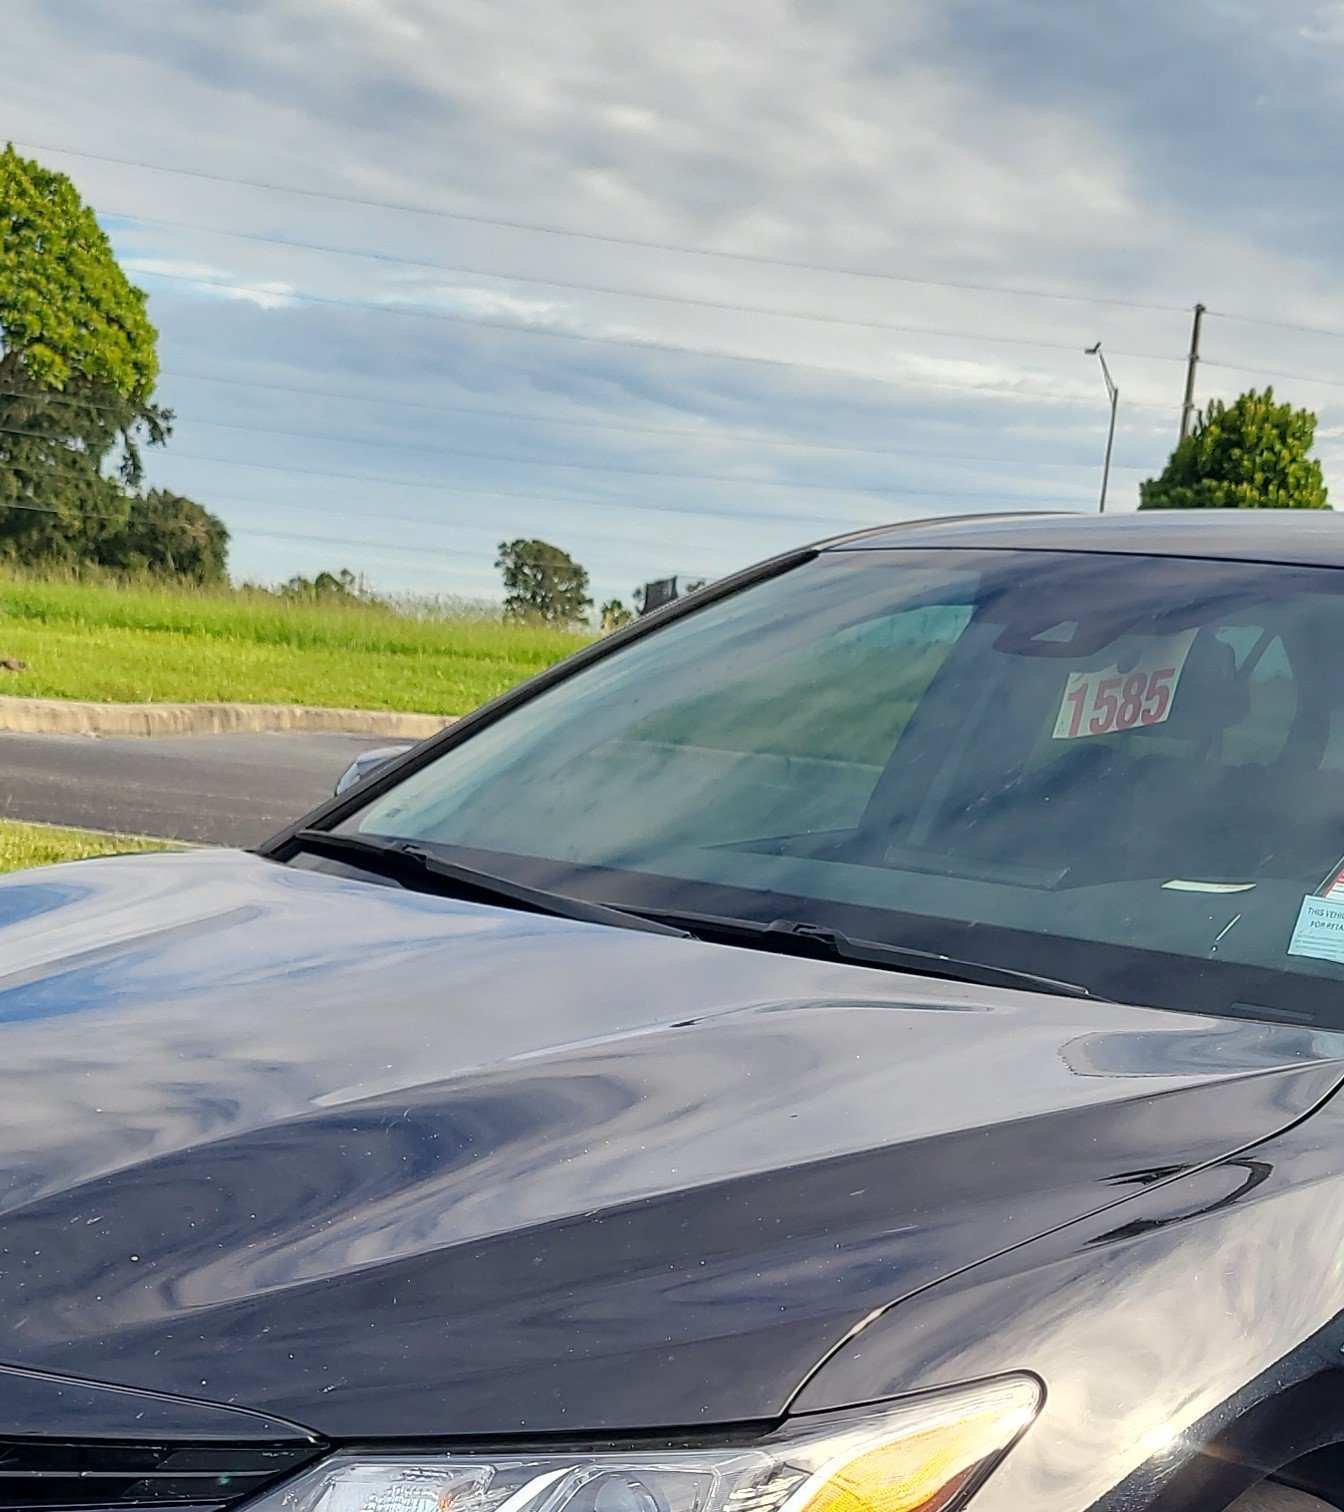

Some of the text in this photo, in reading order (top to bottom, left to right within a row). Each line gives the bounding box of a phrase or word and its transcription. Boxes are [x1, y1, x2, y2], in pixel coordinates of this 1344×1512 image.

[1067, 667, 1176, 738] 1585
[1308, 907, 1325, 917] THIS
[1309, 920, 1326, 928] FOR
